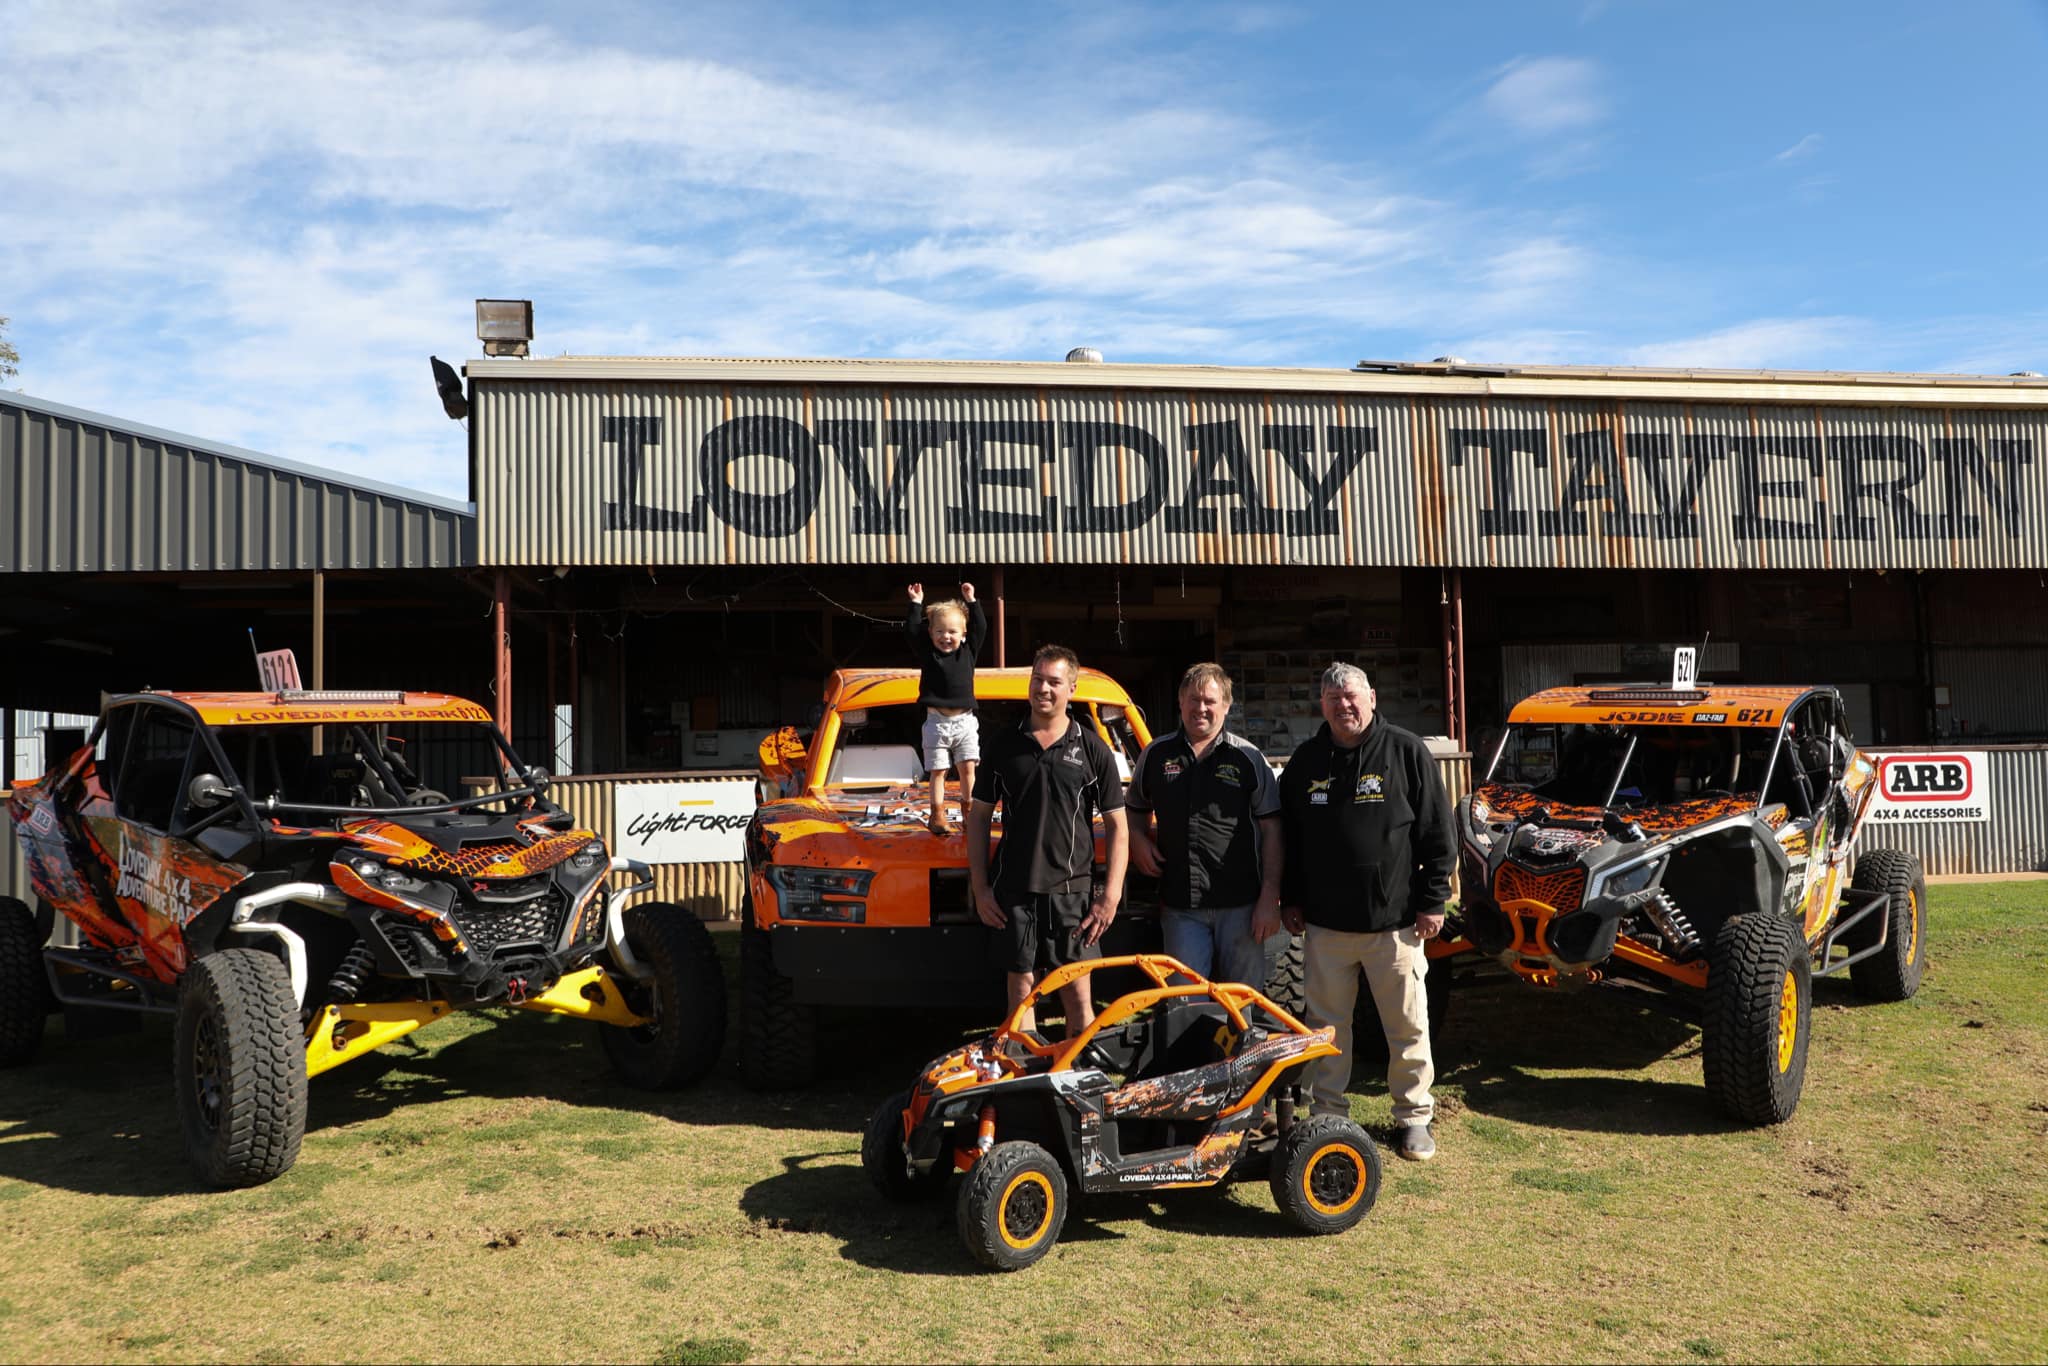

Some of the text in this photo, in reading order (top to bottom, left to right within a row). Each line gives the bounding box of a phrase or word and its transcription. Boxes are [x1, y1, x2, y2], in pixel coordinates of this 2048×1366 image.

[602, 415, 2032, 541] LOVEDAY TAVERN
[262, 653, 297, 691] 6121
[1677, 652, 1693, 682] 621
[236, 709, 349, 722] LOVEDAY
[400, 708, 461, 720] PARK
[1599, 711, 1685, 723] JODIE
[1736, 708, 1774, 723] 621
[1891, 764, 1964, 792] ARB
[1873, 807, 1983, 820] 4X4 ACCESSORIES
[119, 830, 162, 889] LOVEDAY
[116, 870, 168, 917] ADVENTURE
[1119, 1174, 1155, 1182] LOVEDAY
[1171, 1172, 1193, 1181] PARK
